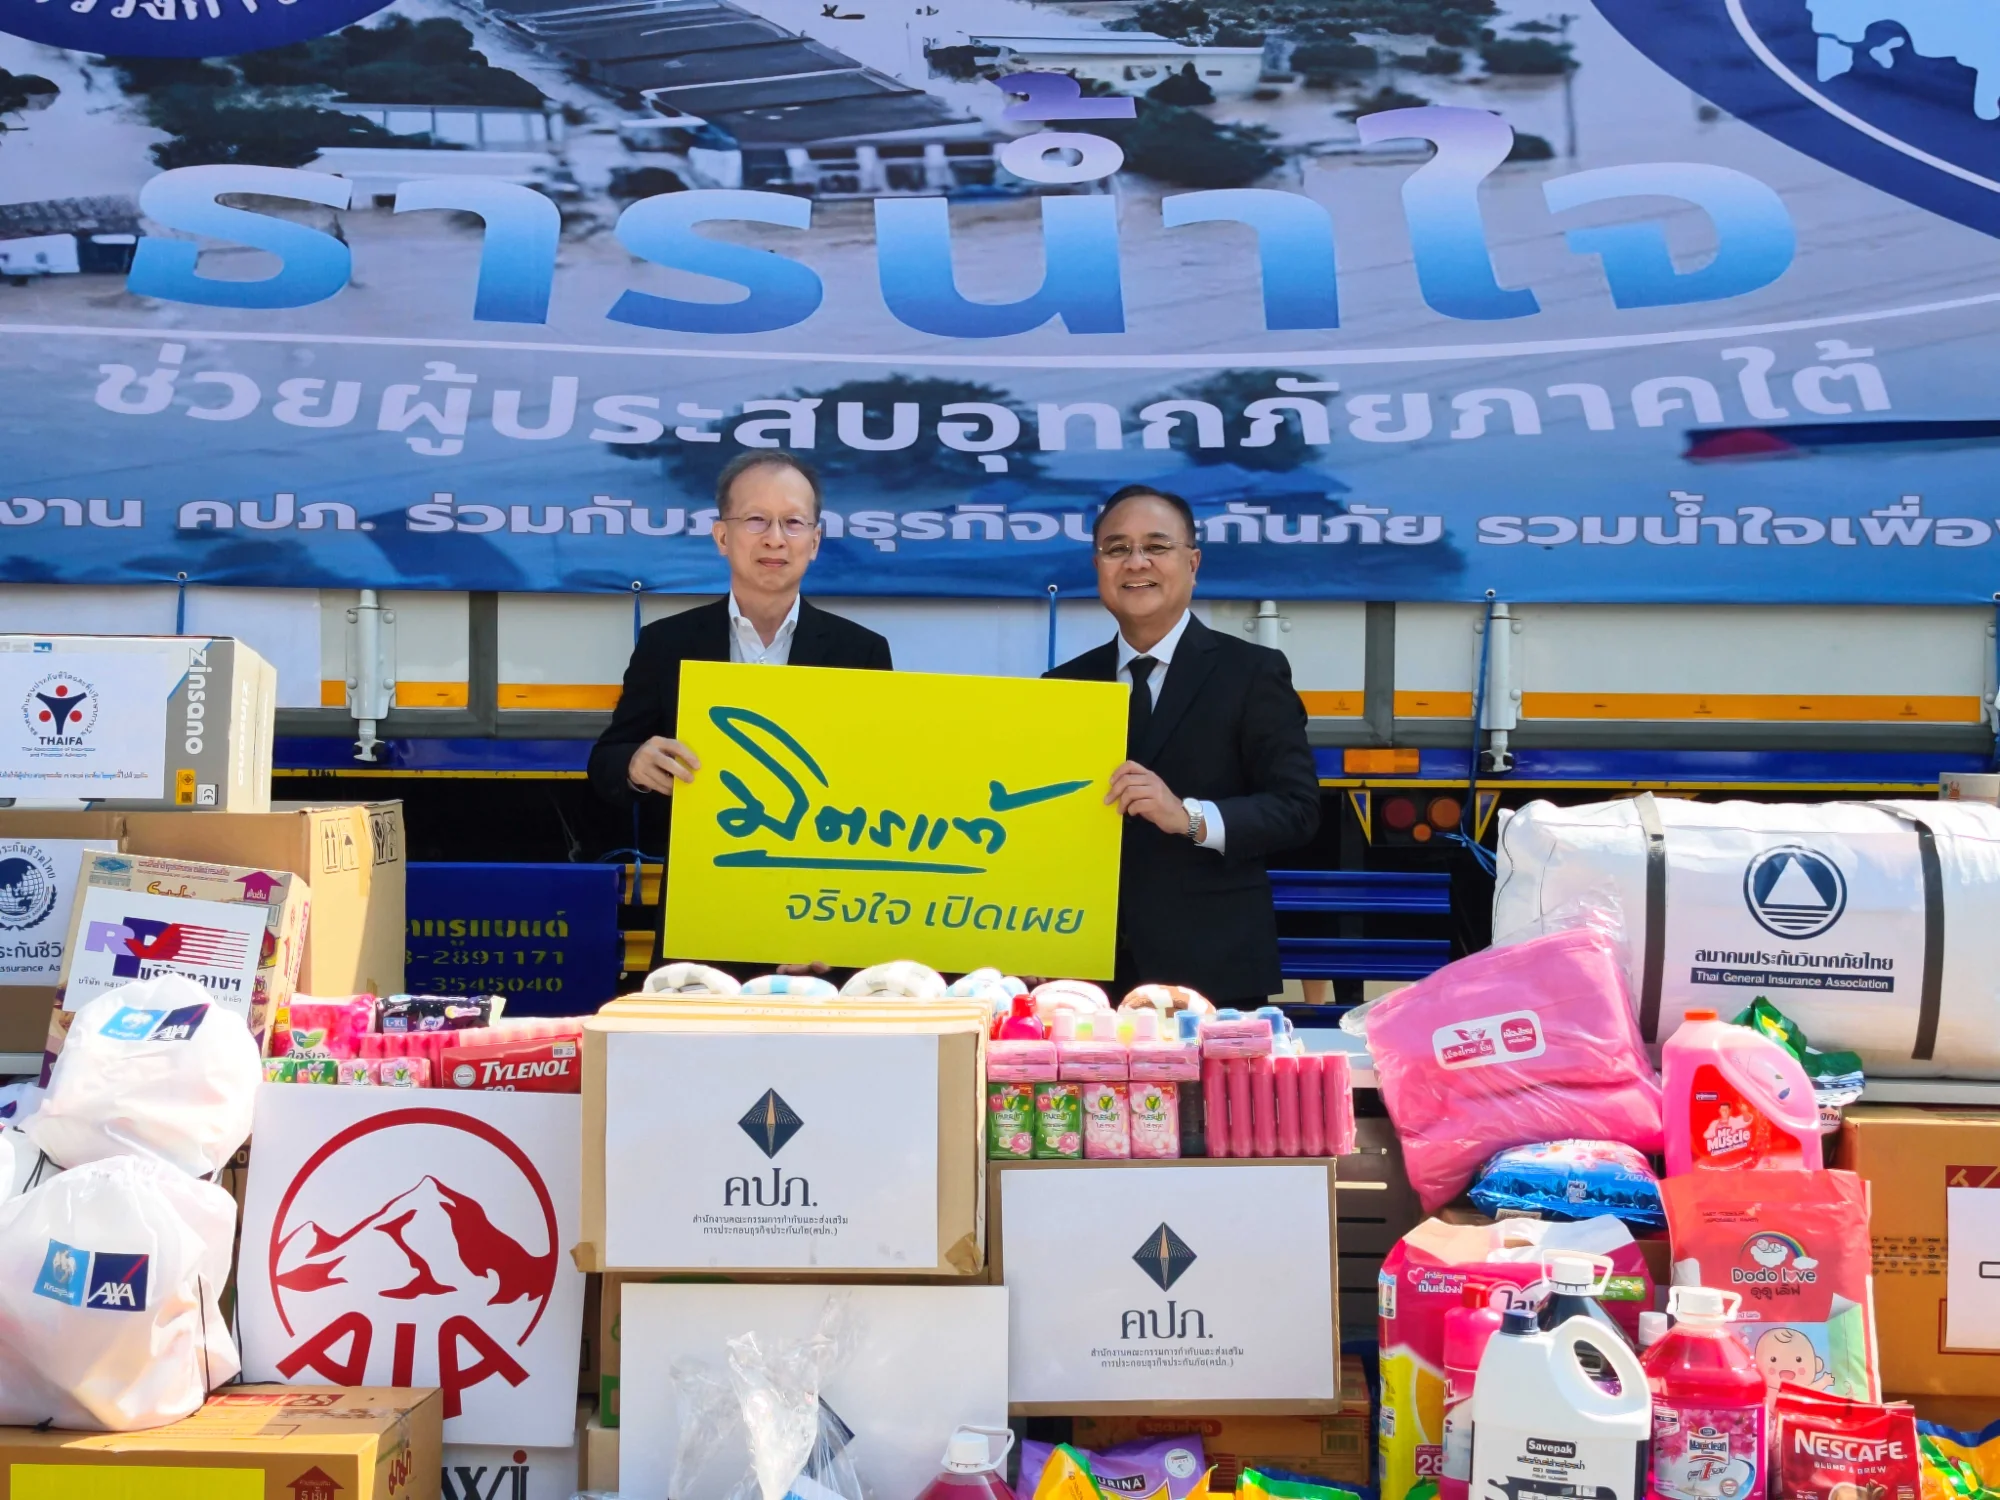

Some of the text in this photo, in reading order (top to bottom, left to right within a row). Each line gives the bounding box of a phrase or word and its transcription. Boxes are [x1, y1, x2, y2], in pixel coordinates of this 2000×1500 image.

[127, 71, 1796, 338] ธารน้ำใจ
[94, 339, 1892, 472] ช่วยผู้ประสบอุทกภัยภาคใต้
[179, 493, 377, 531] คปภ.
[1477, 491, 2000, 547] รวมน้ำใจเพื่อ
[185, 648, 212, 755] zinsano
[39, 736, 83, 746] THAIFA
[708, 706, 1094, 854] มิตรแท้
[785, 889, 1084, 934] จริงใจ เปิดเผย
[1695, 949, 1893, 971] สมาคมประกันวินาศภัยไทย
[1697, 971, 1888, 989] Thai General Insurance Association
[480, 1060, 571, 1084] TYLENOL
[723, 1168, 818, 1207] คปภ.
[1732, 1268, 1778, 1283] Dodo
[87, 1282, 136, 1307] AXA
[1120, 1300, 1213, 1339] คปภ.
[276, 1312, 530, 1421] AIA
[1528, 1440, 1573, 1454] Savepak
[1097, 1476, 1142, 1490] URINA
[1858, 1465, 1887, 1474] BREW
